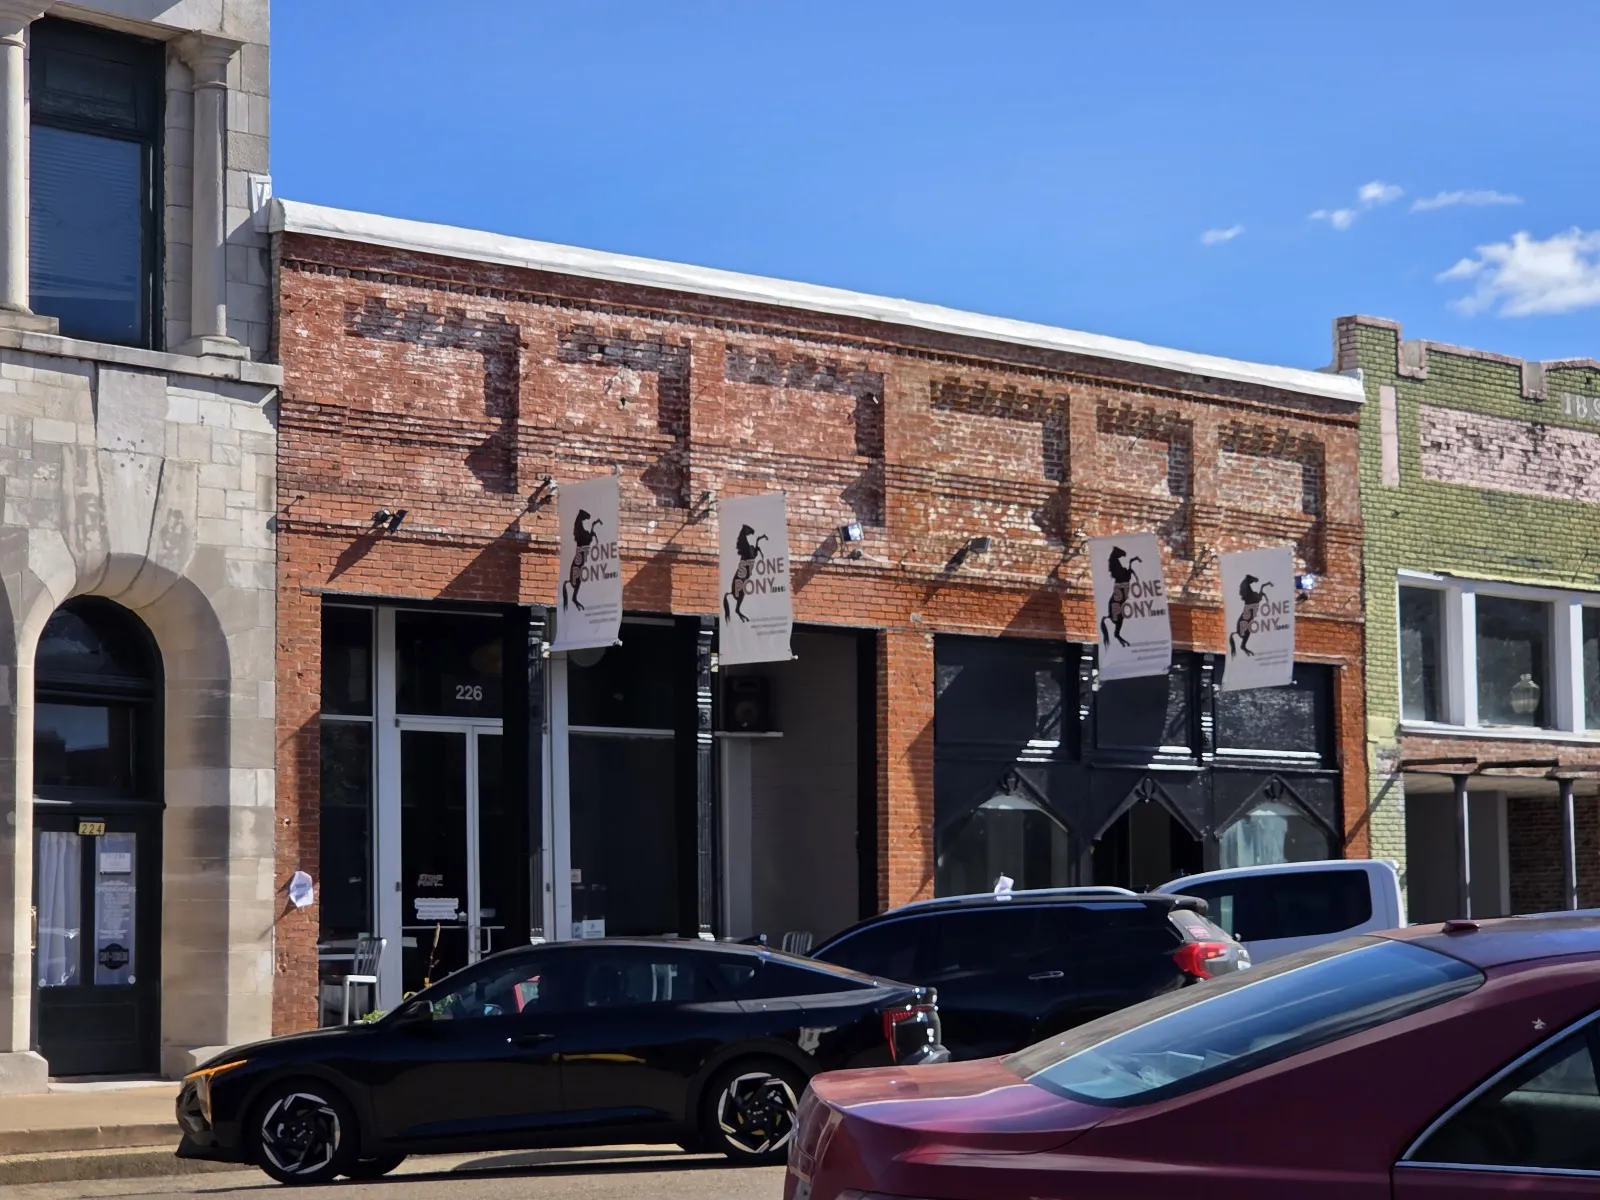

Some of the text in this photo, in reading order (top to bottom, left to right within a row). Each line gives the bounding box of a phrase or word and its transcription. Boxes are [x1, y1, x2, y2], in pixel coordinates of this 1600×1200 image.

[575, 541, 618, 566] STONE
[571, 563, 608, 586] PONY
[737, 557, 785, 578] STONE
[734, 577, 775, 598] PONY
[1111, 600, 1154, 622] PONY
[1239, 617, 1280, 637] PONY
[455, 684, 483, 701] 226
[81, 823, 102, 834] 224
